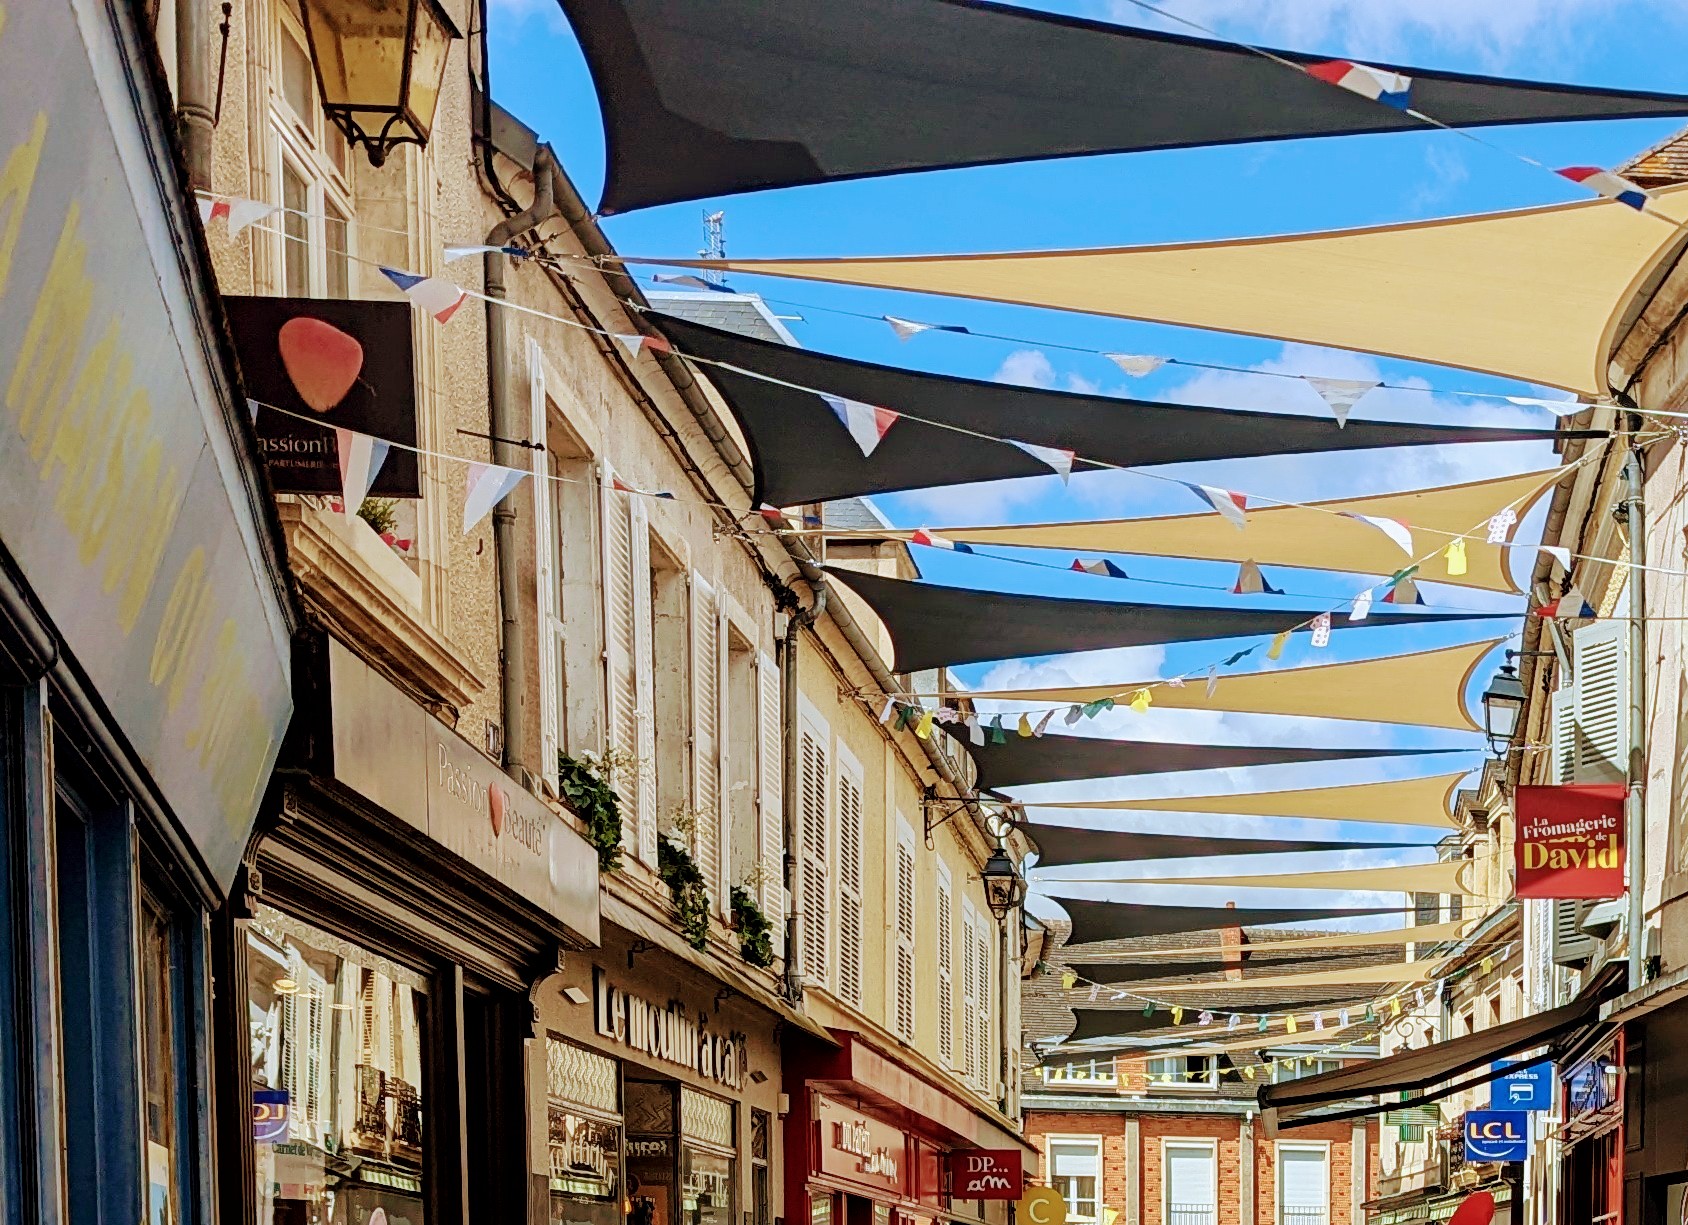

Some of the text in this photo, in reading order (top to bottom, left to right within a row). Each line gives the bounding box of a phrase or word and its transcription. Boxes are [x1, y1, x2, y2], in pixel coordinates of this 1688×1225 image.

[438, 743, 542, 857] Passion Beauté
[1523, 814, 1617, 839] Fromagerie
[1532, 817, 1549, 828] La
[1595, 832, 1607, 841] de
[1523, 833, 1618, 870] David
[598, 969, 627, 1042] Le
[628, 993, 699, 1071] moulin
[1470, 1121, 1521, 1139] LCL
[1029, 1198, 1050, 1224] C
